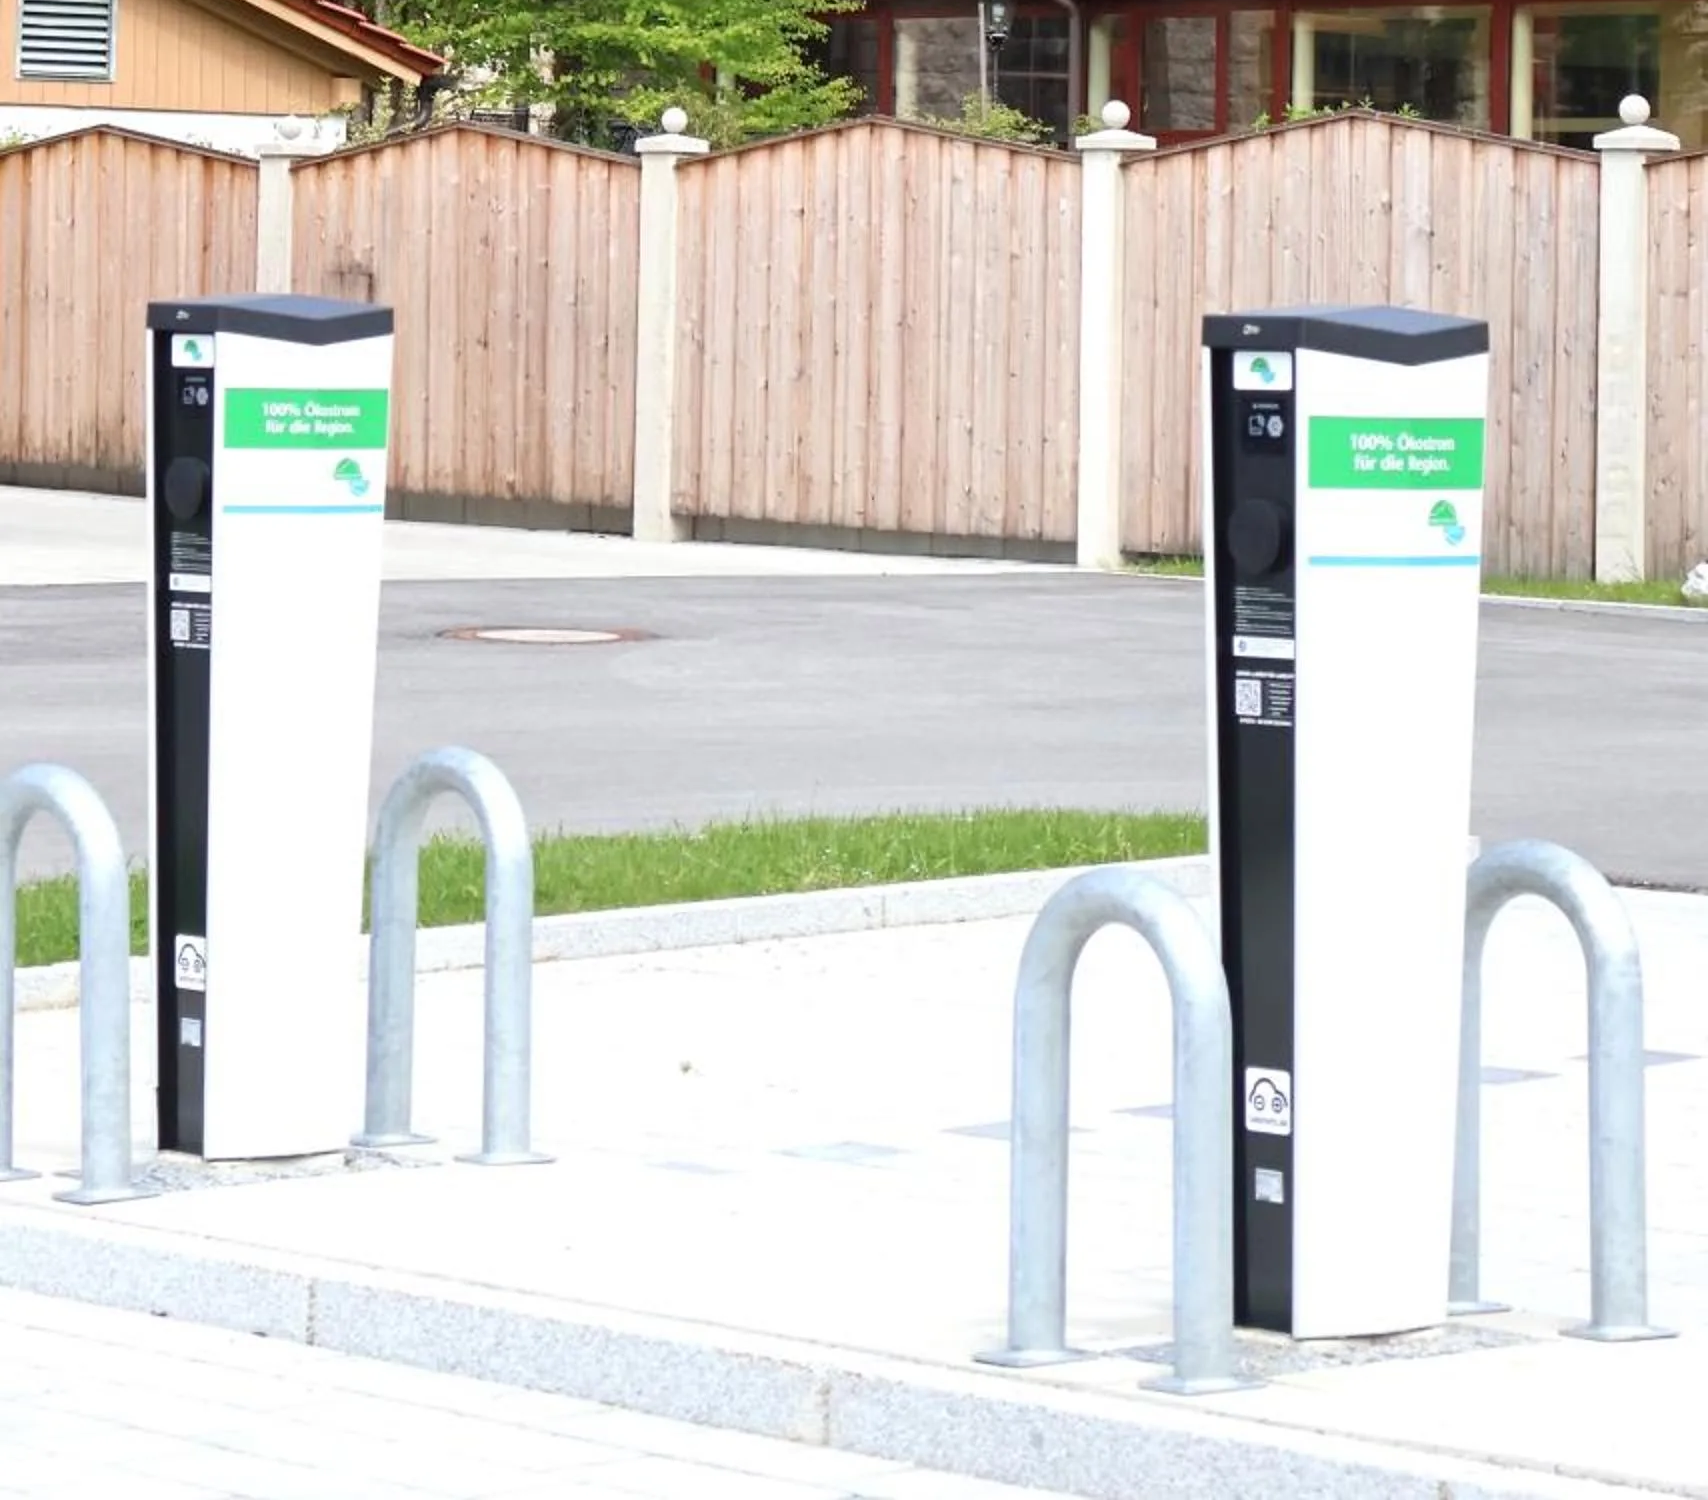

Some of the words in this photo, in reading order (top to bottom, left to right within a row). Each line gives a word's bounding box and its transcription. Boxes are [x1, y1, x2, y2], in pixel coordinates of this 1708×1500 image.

[262, 402, 301, 417] 100%
[265, 419, 285, 433] für
[289, 419, 310, 434] die
[1350, 433, 1393, 451] 100%
[1354, 454, 1376, 470] für
[1380, 453, 1404, 470] die
